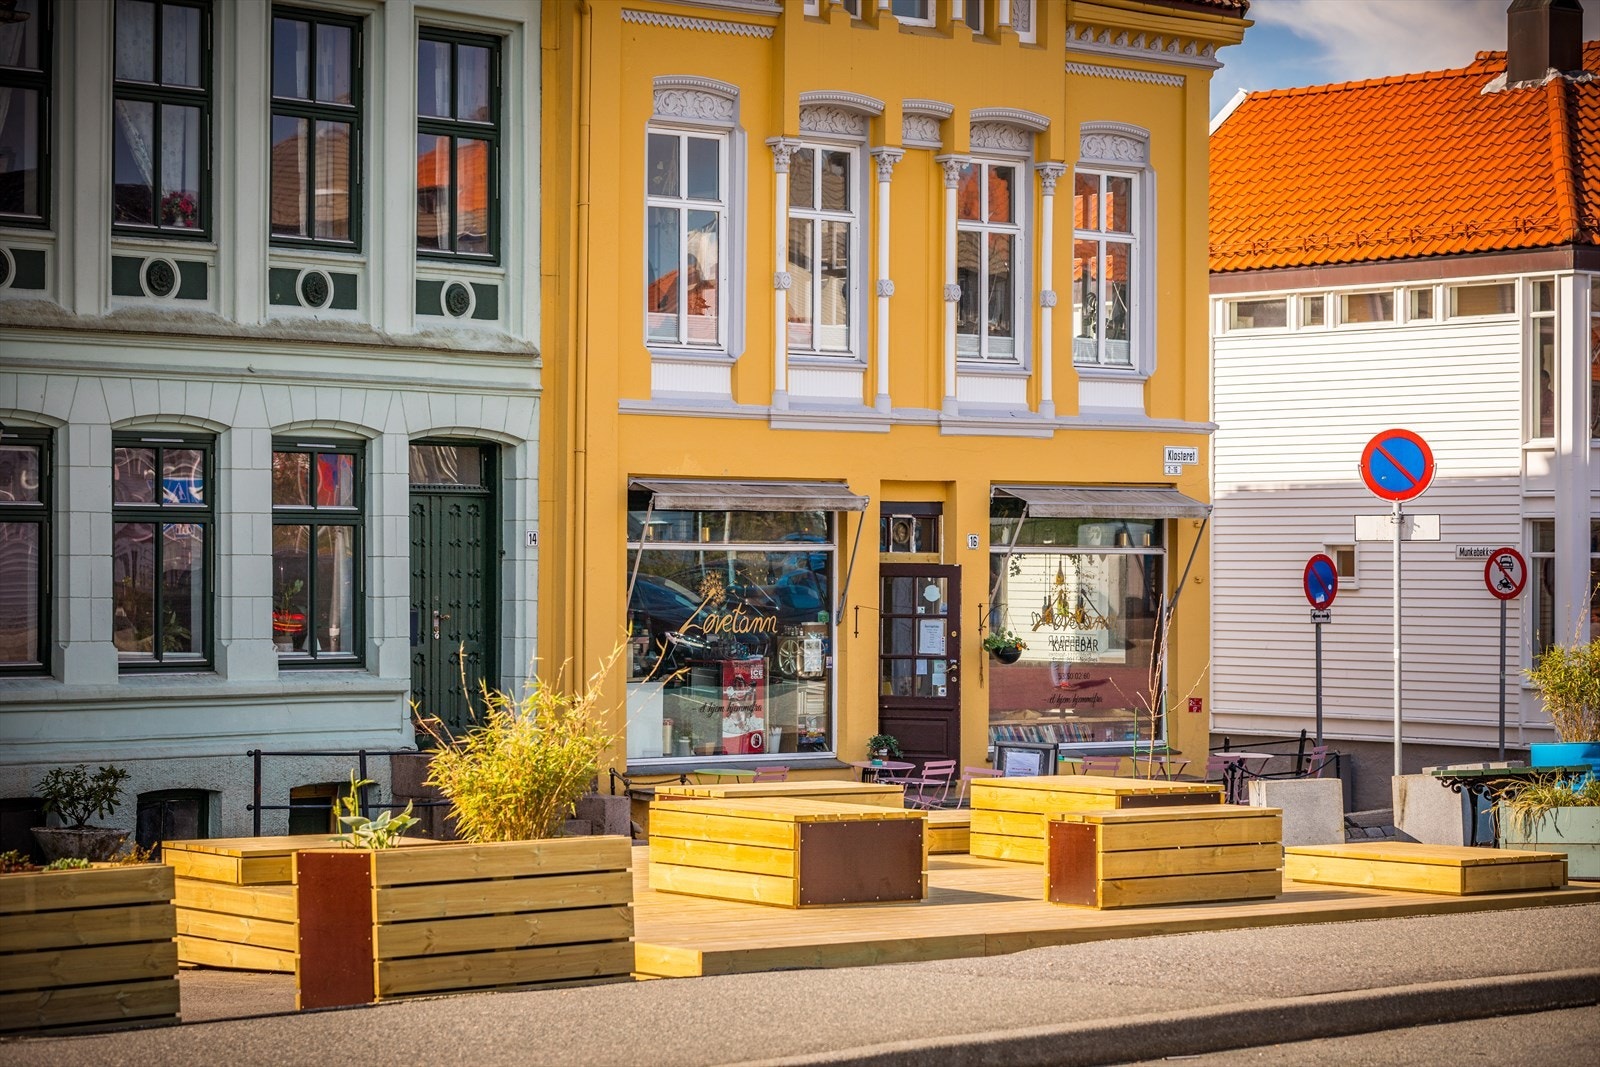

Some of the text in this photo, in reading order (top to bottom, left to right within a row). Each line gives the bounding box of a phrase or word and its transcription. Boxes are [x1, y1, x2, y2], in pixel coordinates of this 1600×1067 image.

[1167, 450, 1195, 461] Klosteret
[529, 533, 536, 545] 14
[970, 536, 977, 547] 16
[1459, 547, 1496, 556] Munkebekks
[678, 595, 778, 634] Løvetann
[1052, 639, 1099, 652] KAFFEBAR
[751, 669, 764, 677] ICE
